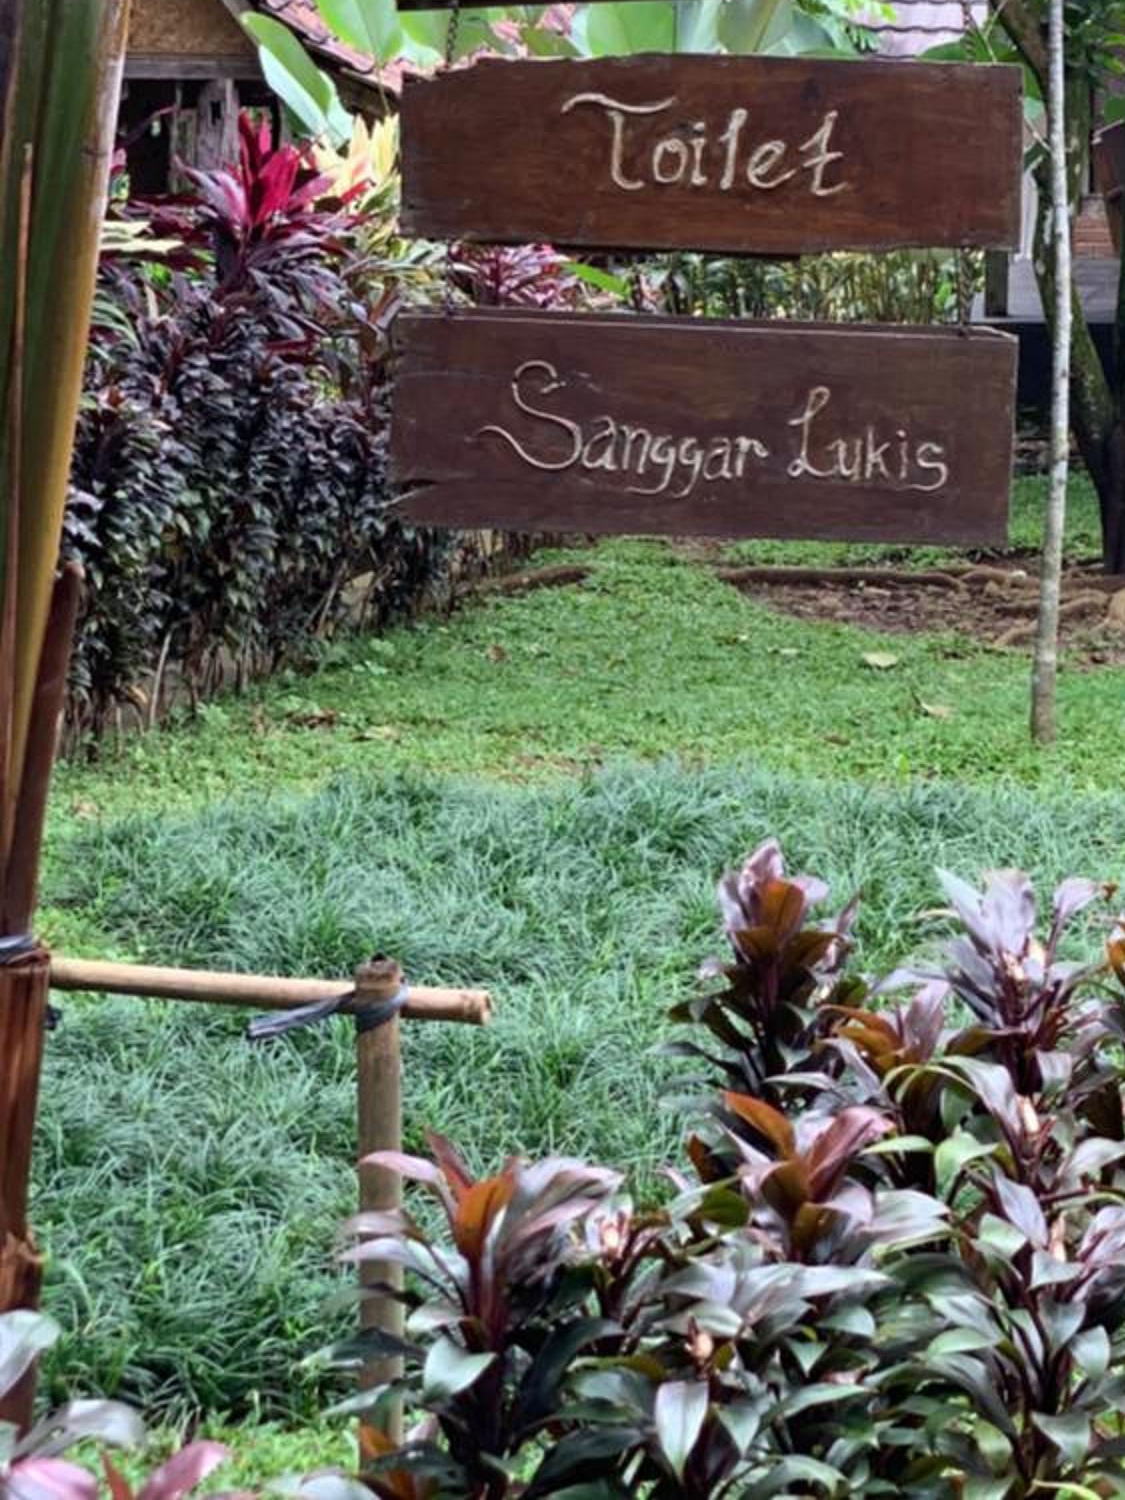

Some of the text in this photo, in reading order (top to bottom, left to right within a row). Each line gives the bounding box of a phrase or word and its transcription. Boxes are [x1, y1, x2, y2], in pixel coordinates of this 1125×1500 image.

[561, 93, 847, 196] Toilet
[465, 360, 948, 496] Sanggar Lukis
